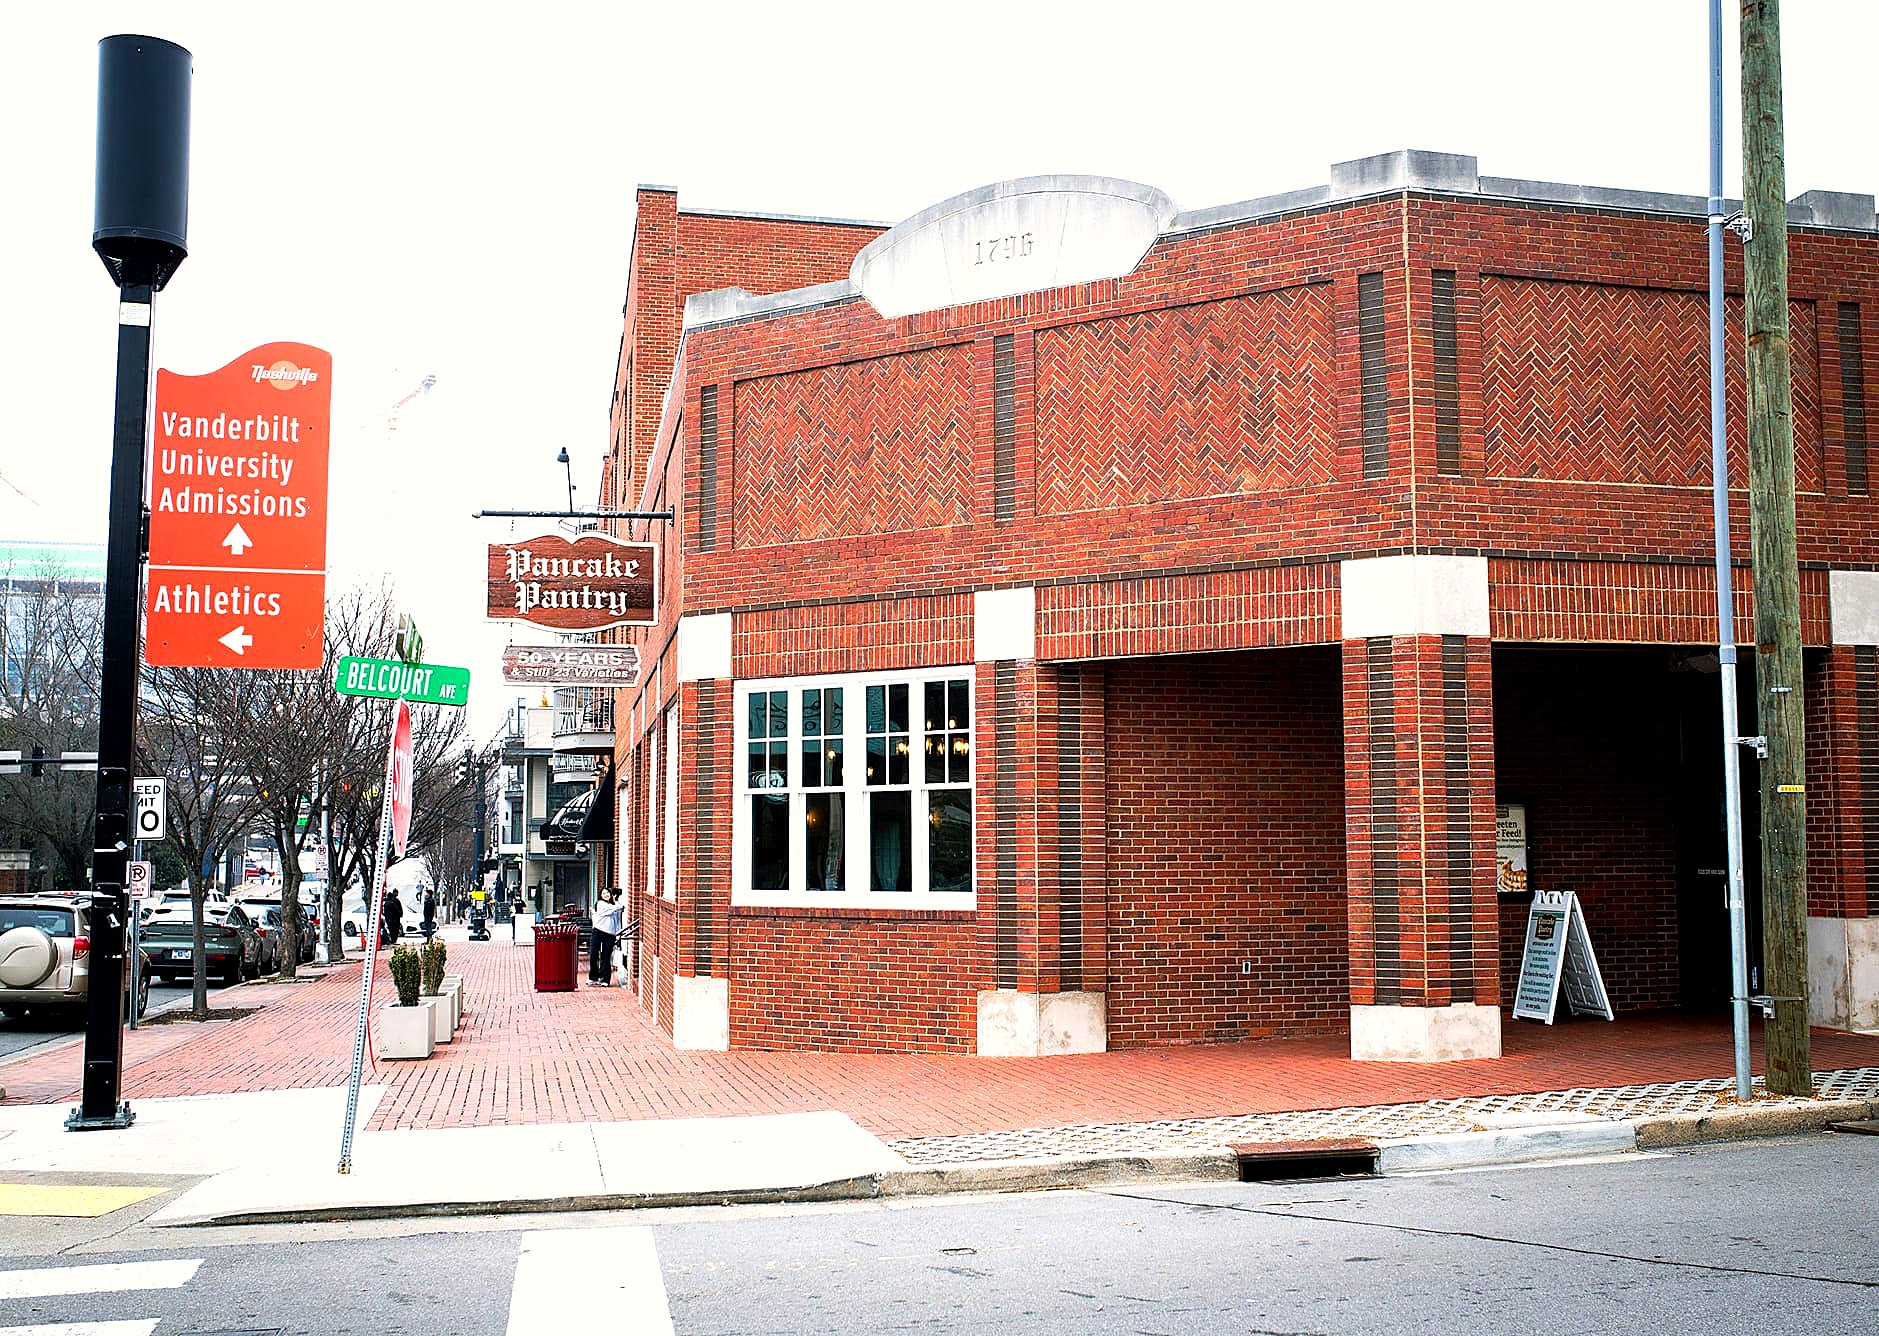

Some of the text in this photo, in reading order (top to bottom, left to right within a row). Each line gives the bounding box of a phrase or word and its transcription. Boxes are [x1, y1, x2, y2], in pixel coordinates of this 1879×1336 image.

[974, 232, 1033, 265] 1796
[252, 364, 318, 385] Nashville
[162, 411, 300, 443] Vanderbilt
[161, 448, 294, 487] University
[158, 486, 307, 518] Admissions
[505, 549, 640, 582] Pancake
[153, 584, 281, 616] Athletics
[514, 581, 628, 616] Pantry
[510, 667, 521, 676] &
[526, 667, 549, 677] Still
[553, 667, 570, 677] 23
[518, 652, 624, 665] 50 YEARS
[346, 662, 457, 699] BELCOURT AVE
[136, 785, 161, 795] EED
[137, 797, 156, 807] MIT
[140, 810, 159, 832] 0
[1496, 821, 1518, 829] eeten
[1502, 828, 1522, 838] Feed!
